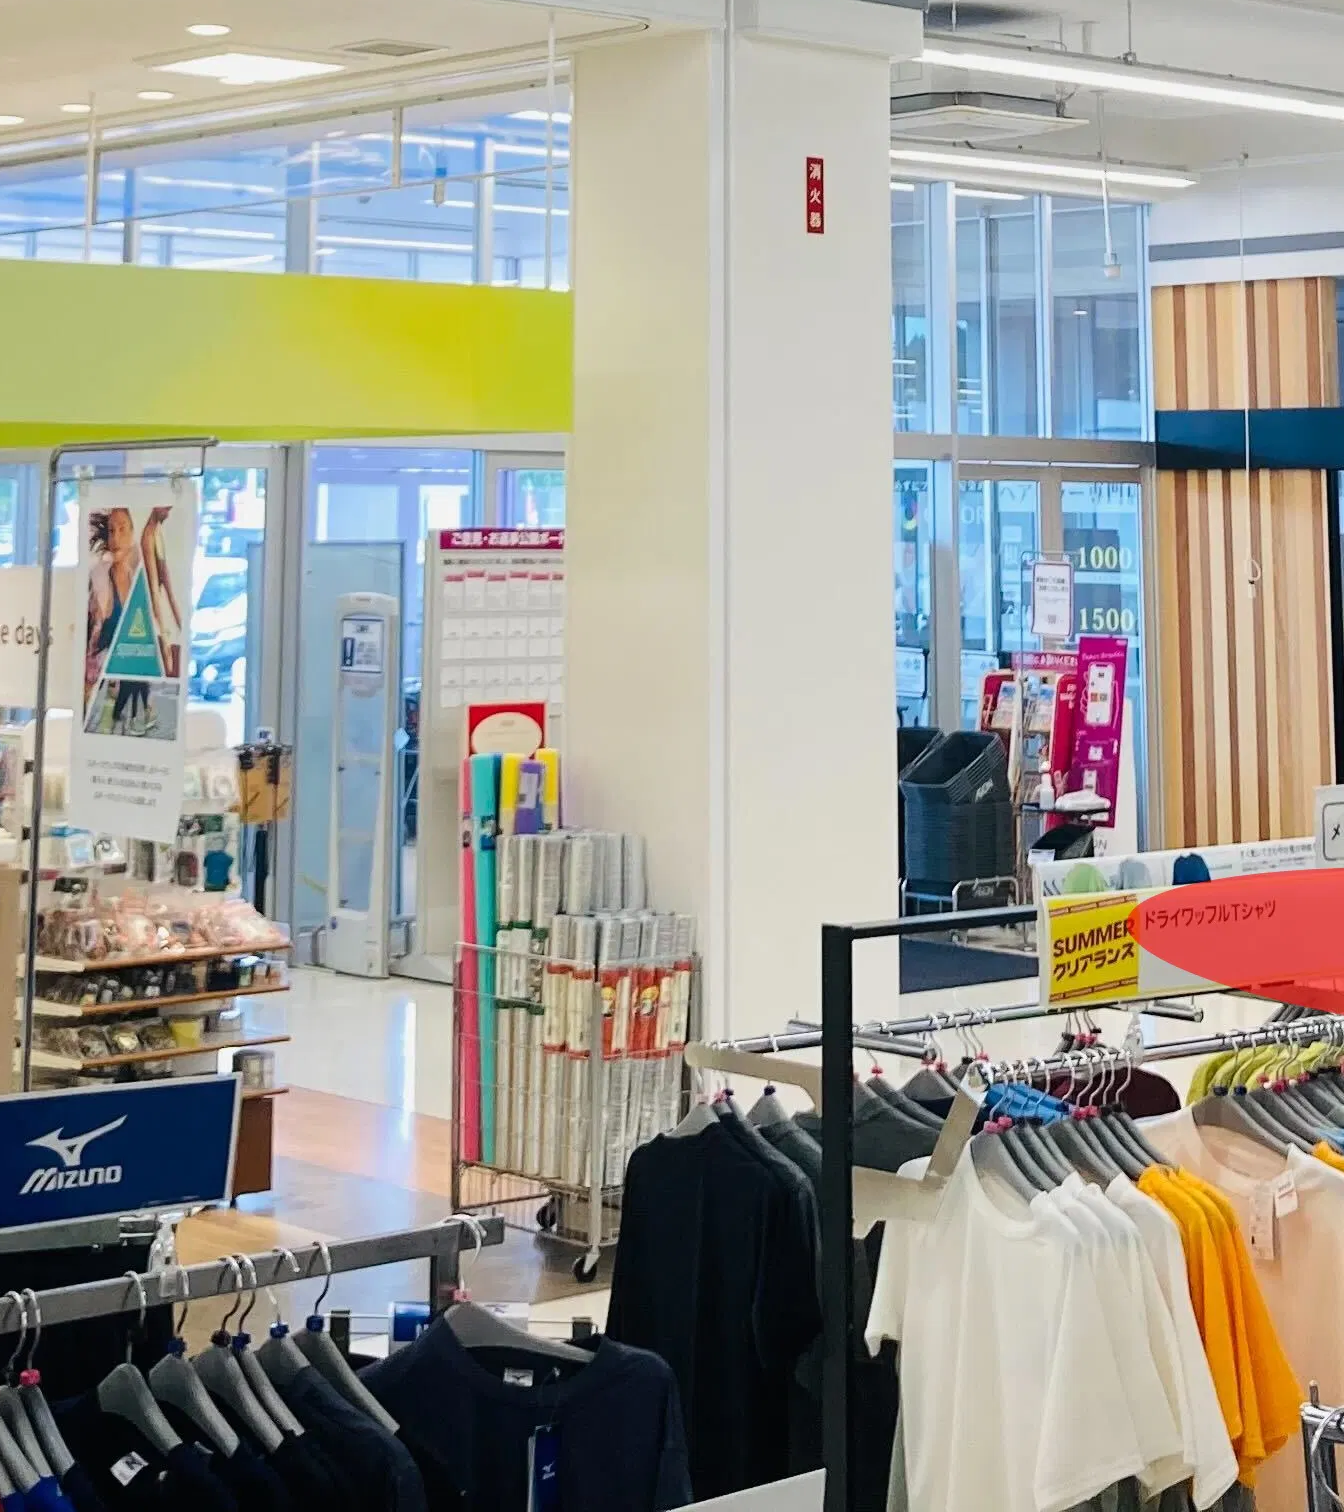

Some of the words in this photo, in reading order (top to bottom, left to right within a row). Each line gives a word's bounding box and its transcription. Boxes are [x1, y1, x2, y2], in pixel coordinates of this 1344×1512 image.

[809, 163, 822, 228] 消火器
[1078, 546, 1133, 570] 1000
[1079, 607, 1135, 632] 1500
[1145, 899, 1276, 930] ドライワッフルTシャツ
[1053, 918, 1136, 958] SUMMER
[1053, 941, 1136, 982] クリアランス
[18, 1165, 123, 1195] MIZUNO
